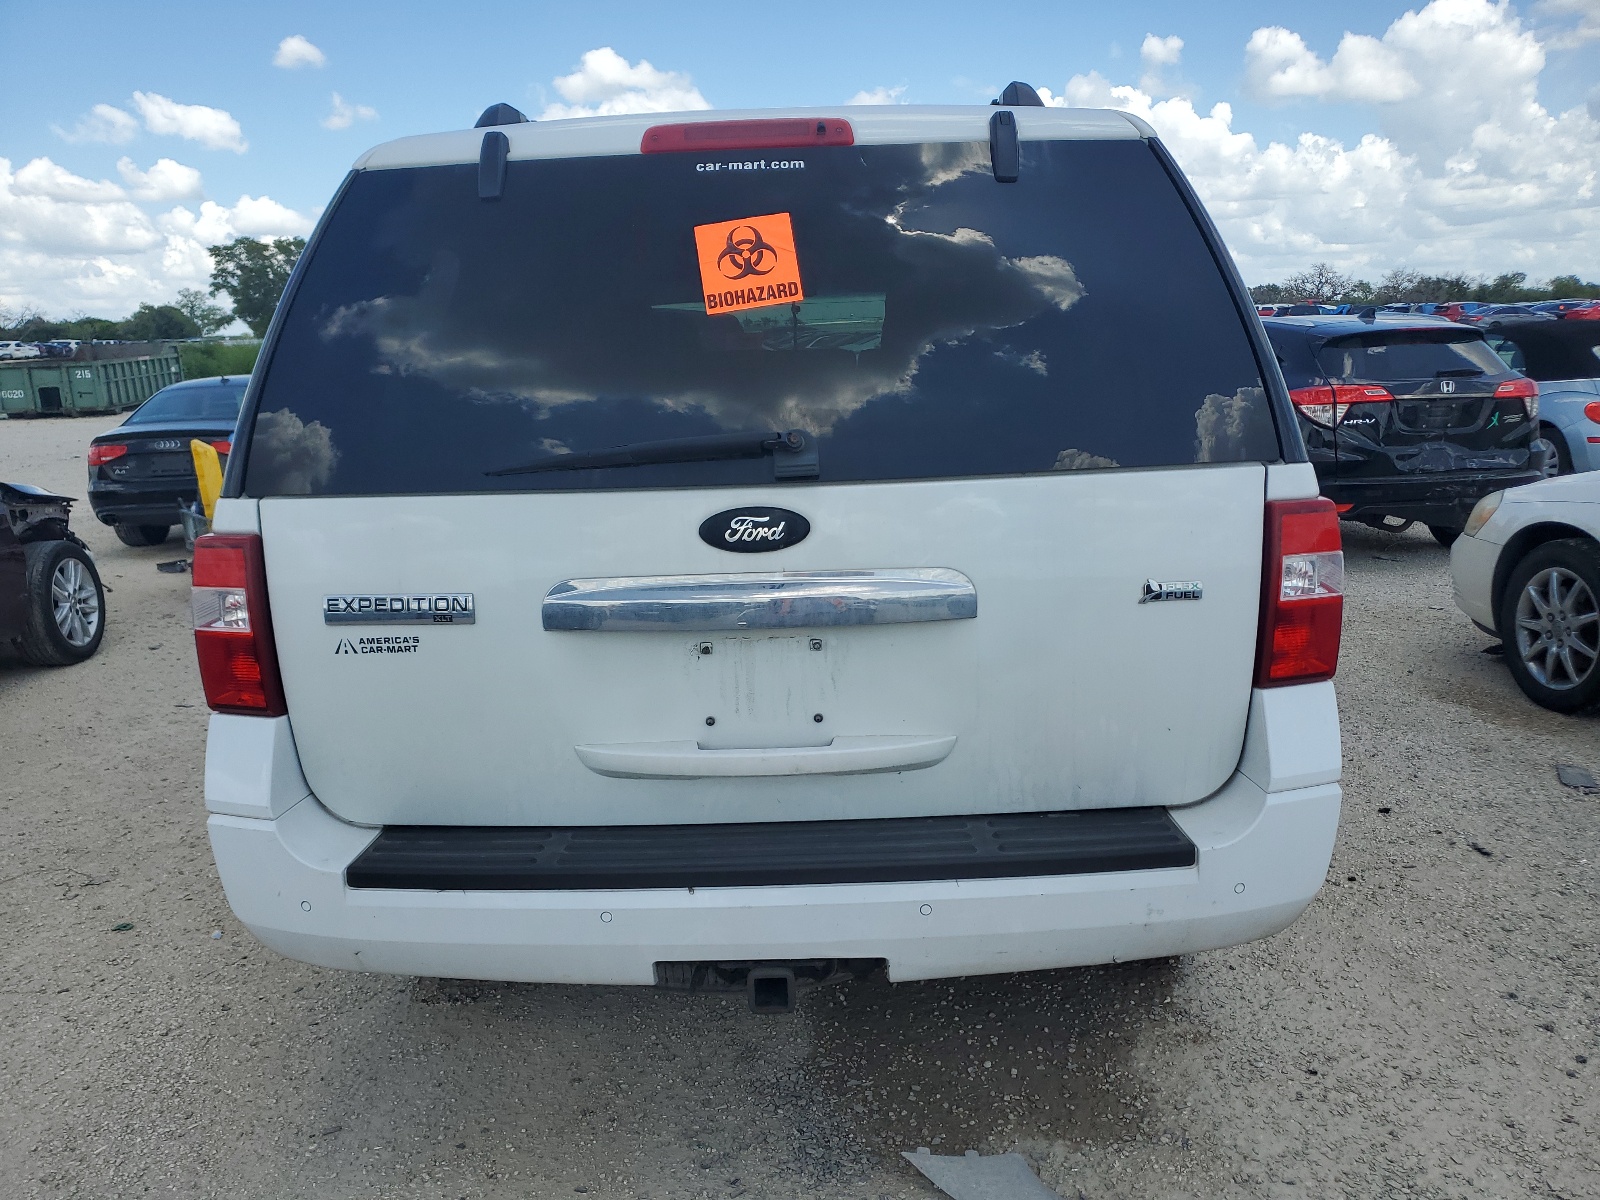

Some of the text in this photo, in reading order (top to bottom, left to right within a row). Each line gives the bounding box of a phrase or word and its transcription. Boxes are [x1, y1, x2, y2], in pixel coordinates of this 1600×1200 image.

[696, 159, 805, 172] car-mart.com
[706, 281, 799, 310] BIOHAZARD
[1343, 418, 1376, 426] HR-V
[724, 516, 786, 543] Ford
[1166, 591, 1200, 599] FUEL
[326, 597, 468, 613] EXPEDITION
[358, 636, 420, 645] AMERICA'S
